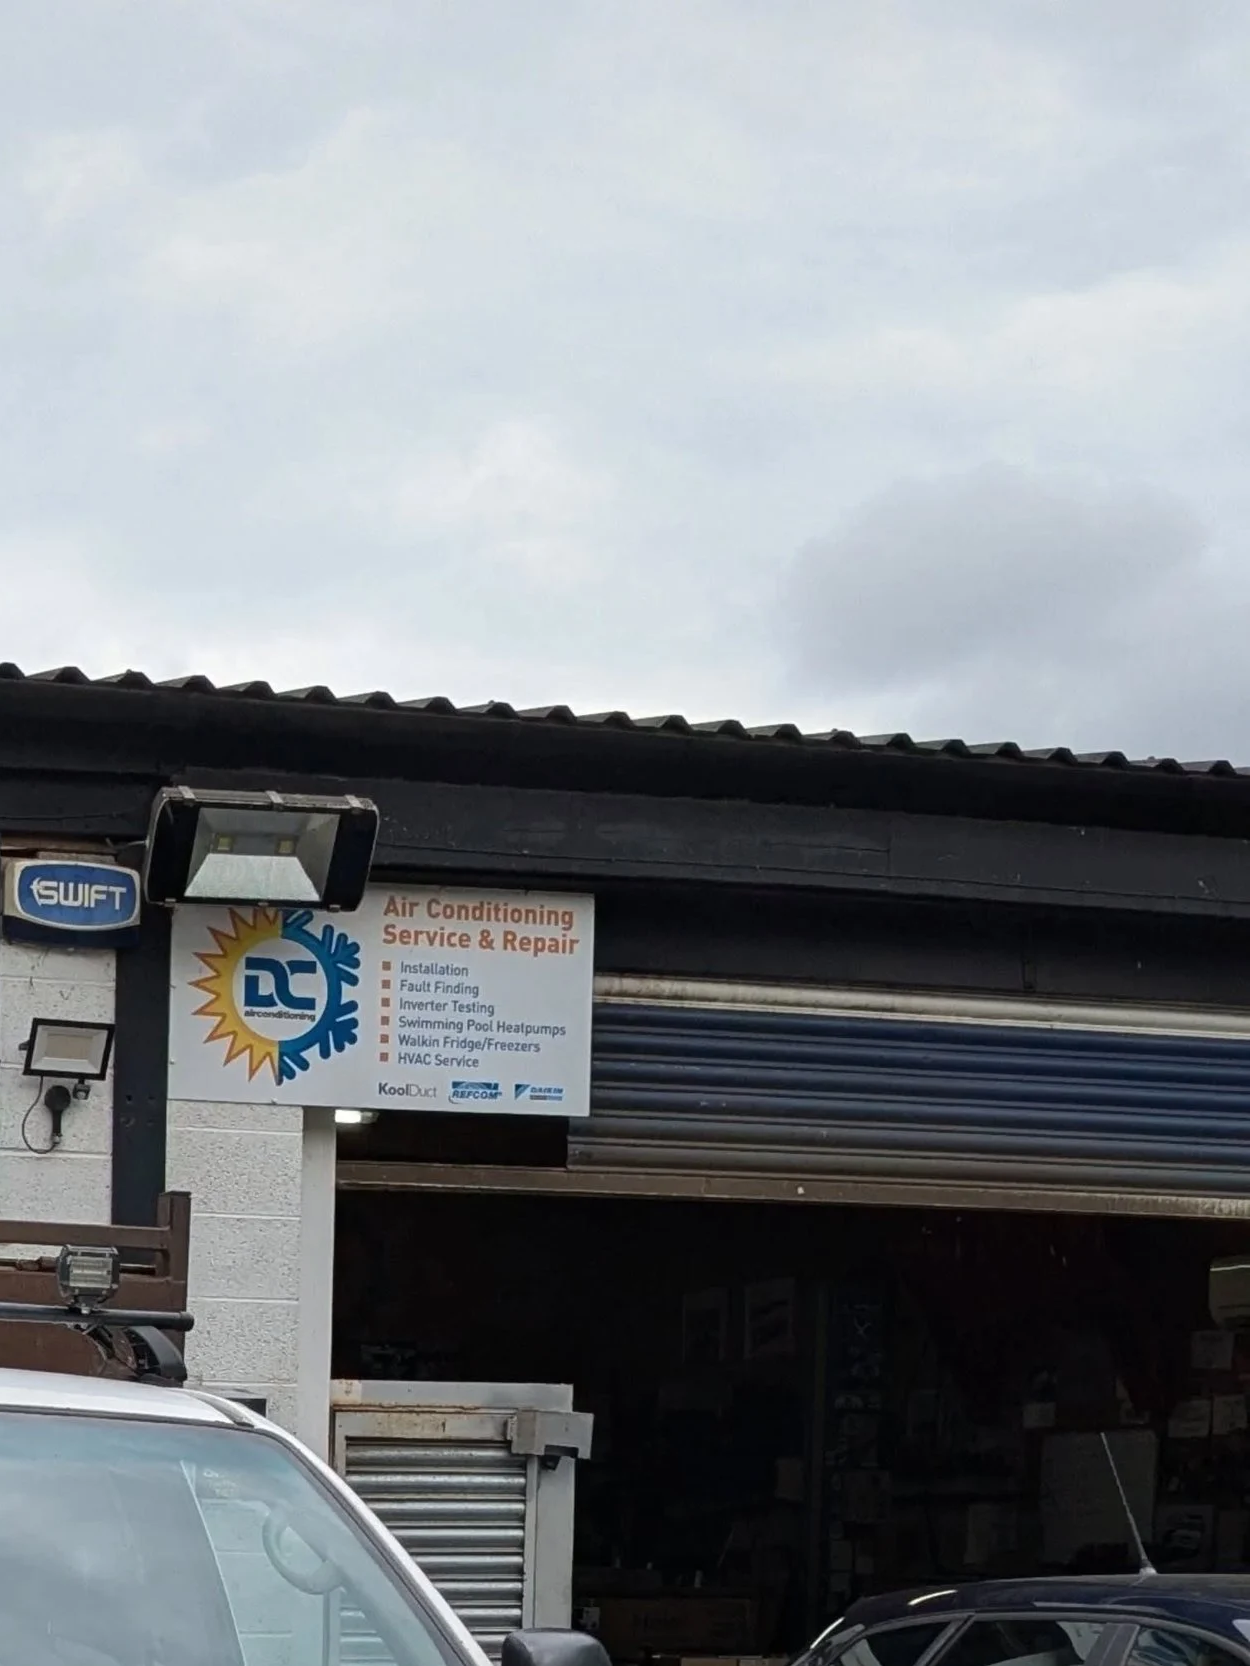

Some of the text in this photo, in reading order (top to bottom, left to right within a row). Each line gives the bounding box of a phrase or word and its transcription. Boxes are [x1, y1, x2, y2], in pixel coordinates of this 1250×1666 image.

[31, 877, 127, 910] SWIFT
[383, 895, 575, 931] Air Conditioning
[382, 924, 580, 957] Service & Repair
[400, 961, 469, 977] Installation
[400, 979, 480, 998] Fault Finding
[244, 1009, 317, 1022] airconditioning
[399, 997, 495, 1017] Inverter Testing
[398, 1016, 566, 1038] Swimming Pool Heatpumps
[398, 1033, 541, 1053] Walkin Fridge/Freezers
[398, 1051, 479, 1068] HVAC Service
[378, 1081, 437, 1099] KoolDuct
[452, 1089, 499, 1100] REFCOM
